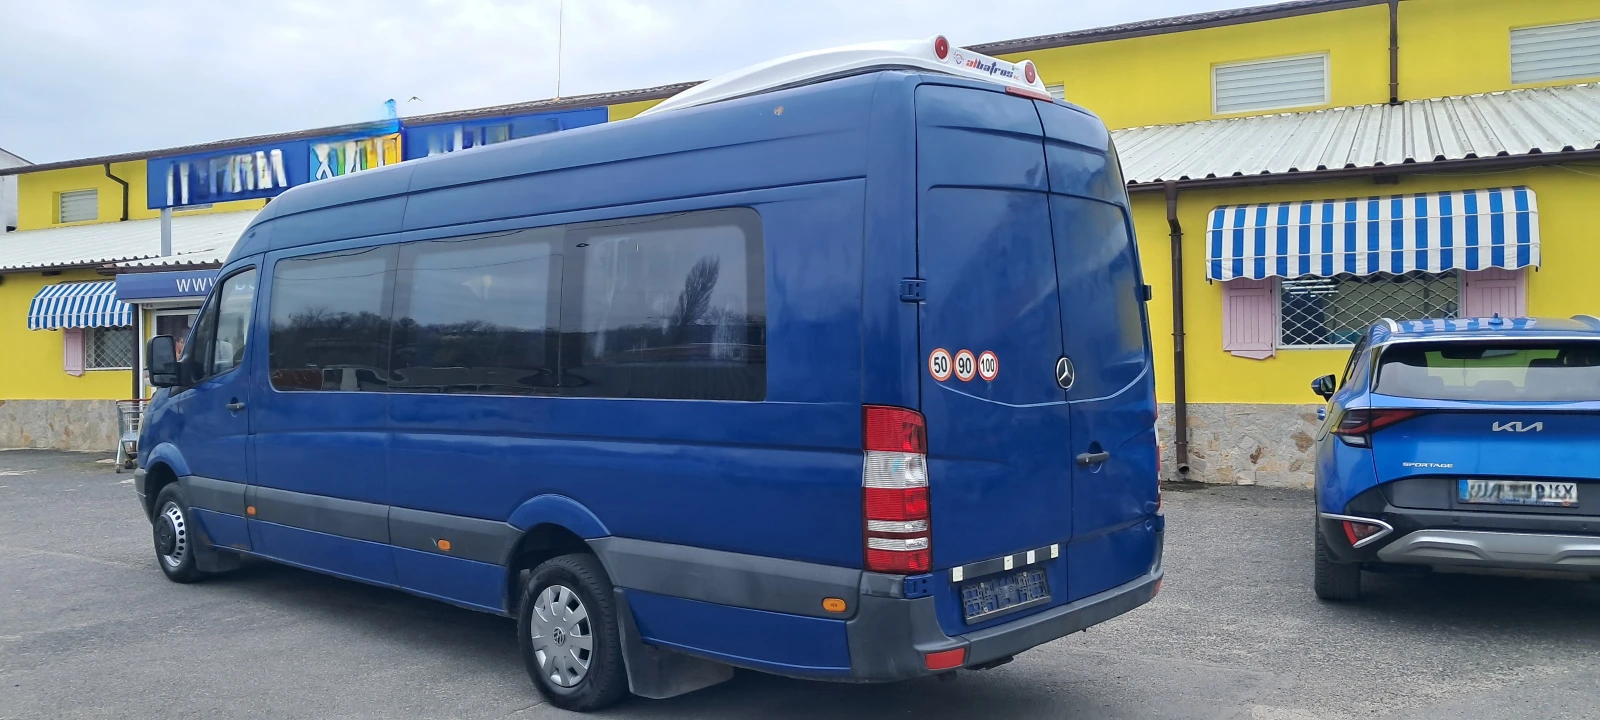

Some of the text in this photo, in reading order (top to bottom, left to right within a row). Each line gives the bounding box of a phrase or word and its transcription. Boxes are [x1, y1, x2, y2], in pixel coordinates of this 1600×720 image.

[966, 58, 1014, 78] albatros
[933, 355, 948, 374] 50
[958, 357, 972, 374] 90
[980, 358, 995, 373] 100
